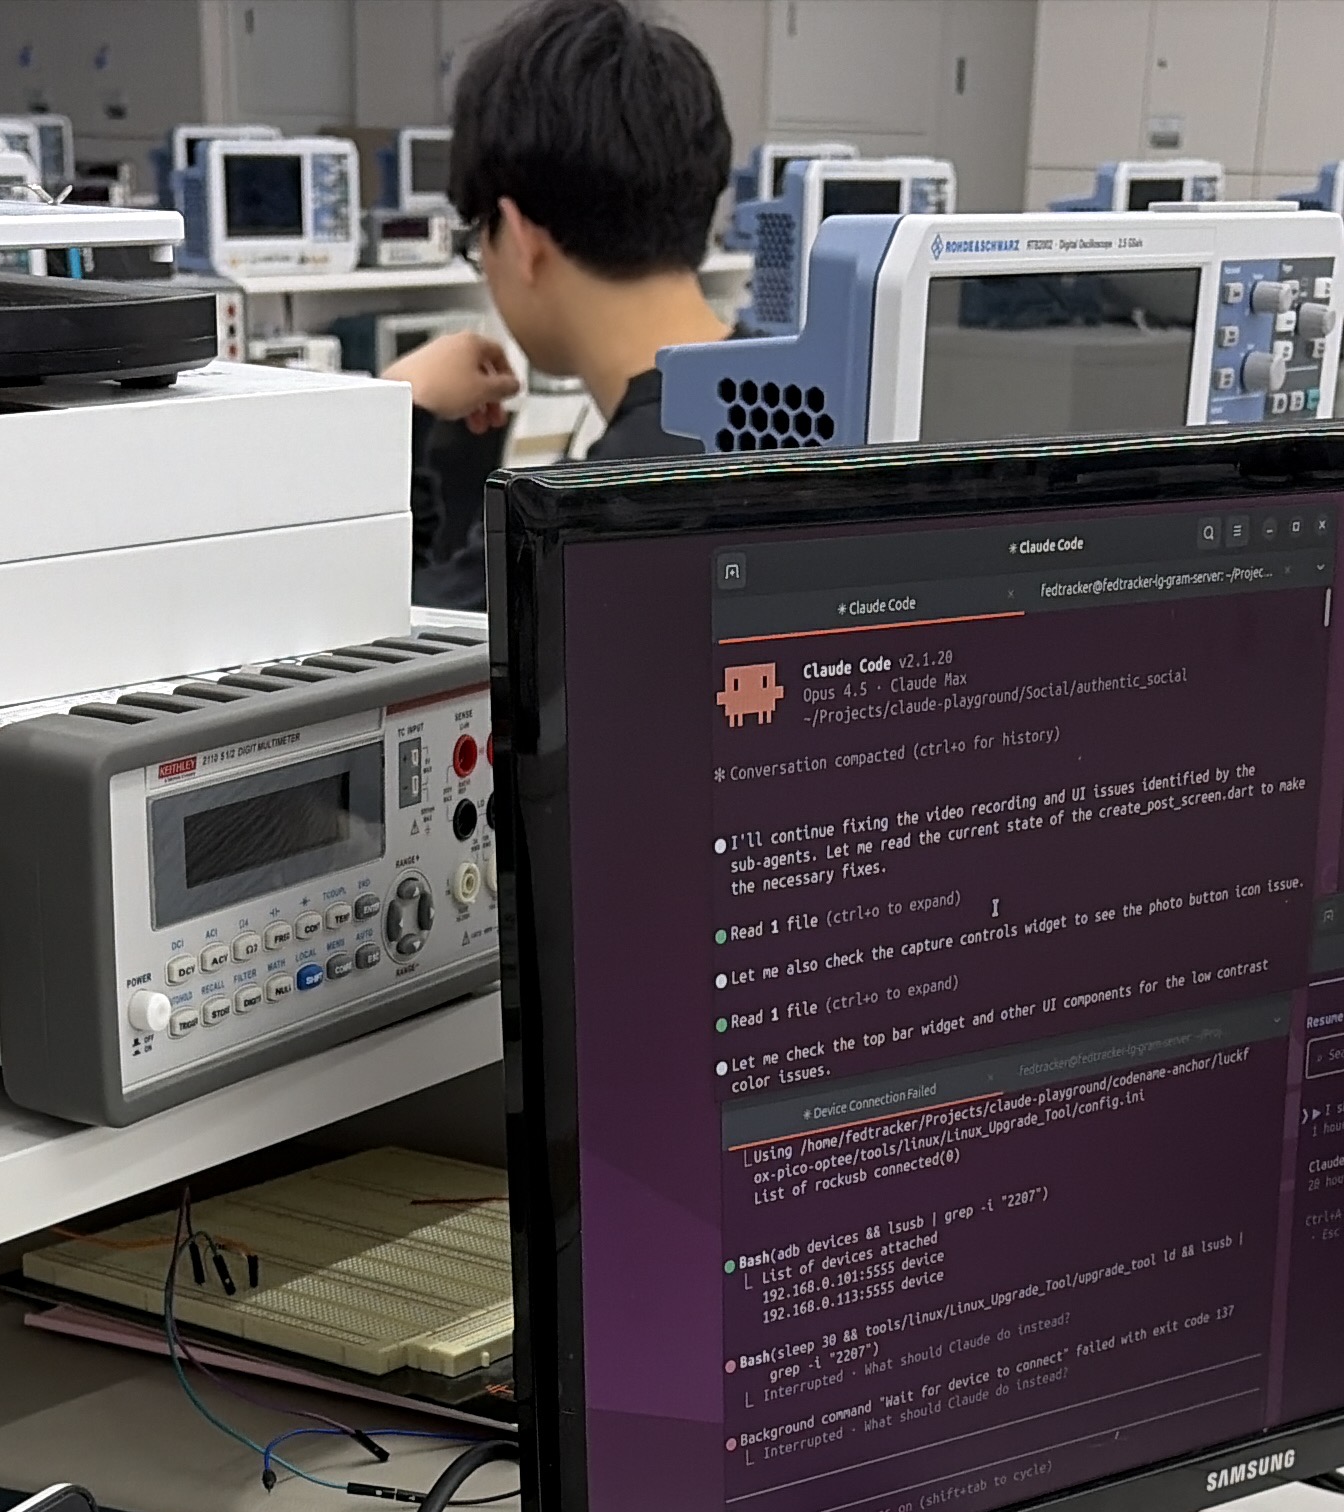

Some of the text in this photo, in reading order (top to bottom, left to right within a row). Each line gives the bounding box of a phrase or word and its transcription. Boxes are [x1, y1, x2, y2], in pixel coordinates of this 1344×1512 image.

[945, 239, 1020, 253] ROHDE&SCHWARZ
[1019, 536, 1084, 555] Claude Code
[849, 597, 916, 615] Claude Code
[803, 646, 953, 679] Claude Code v2.1.20
[803, 669, 967, 706] Opus 4.5 Claude Max
[258, 732, 301, 751] MULTIMETER
[730, 722, 1061, 781] Conversation compacted (ctrl+o for history)
[159, 758, 197, 778] KEITHLEY
[730, 762, 1255, 850] I'll continue fixing the video recording and UI issues identified by the
[730, 859, 888, 895] the necessary fixes.
[731, 887, 961, 940] Read 1 file (ctrl+o to expand)
[126, 972, 152, 989] POWER
[814, 1083, 937, 1120] Device Connection Failed
[739, 1185, 1049, 1270] Bash(adb devices && lsusb grep -i "2207")
[741, 1306, 1234, 1446] Background command "Wait for device to connect" failed with exit code 137
[1206, 1448, 1296, 1493] SAMSUNG
